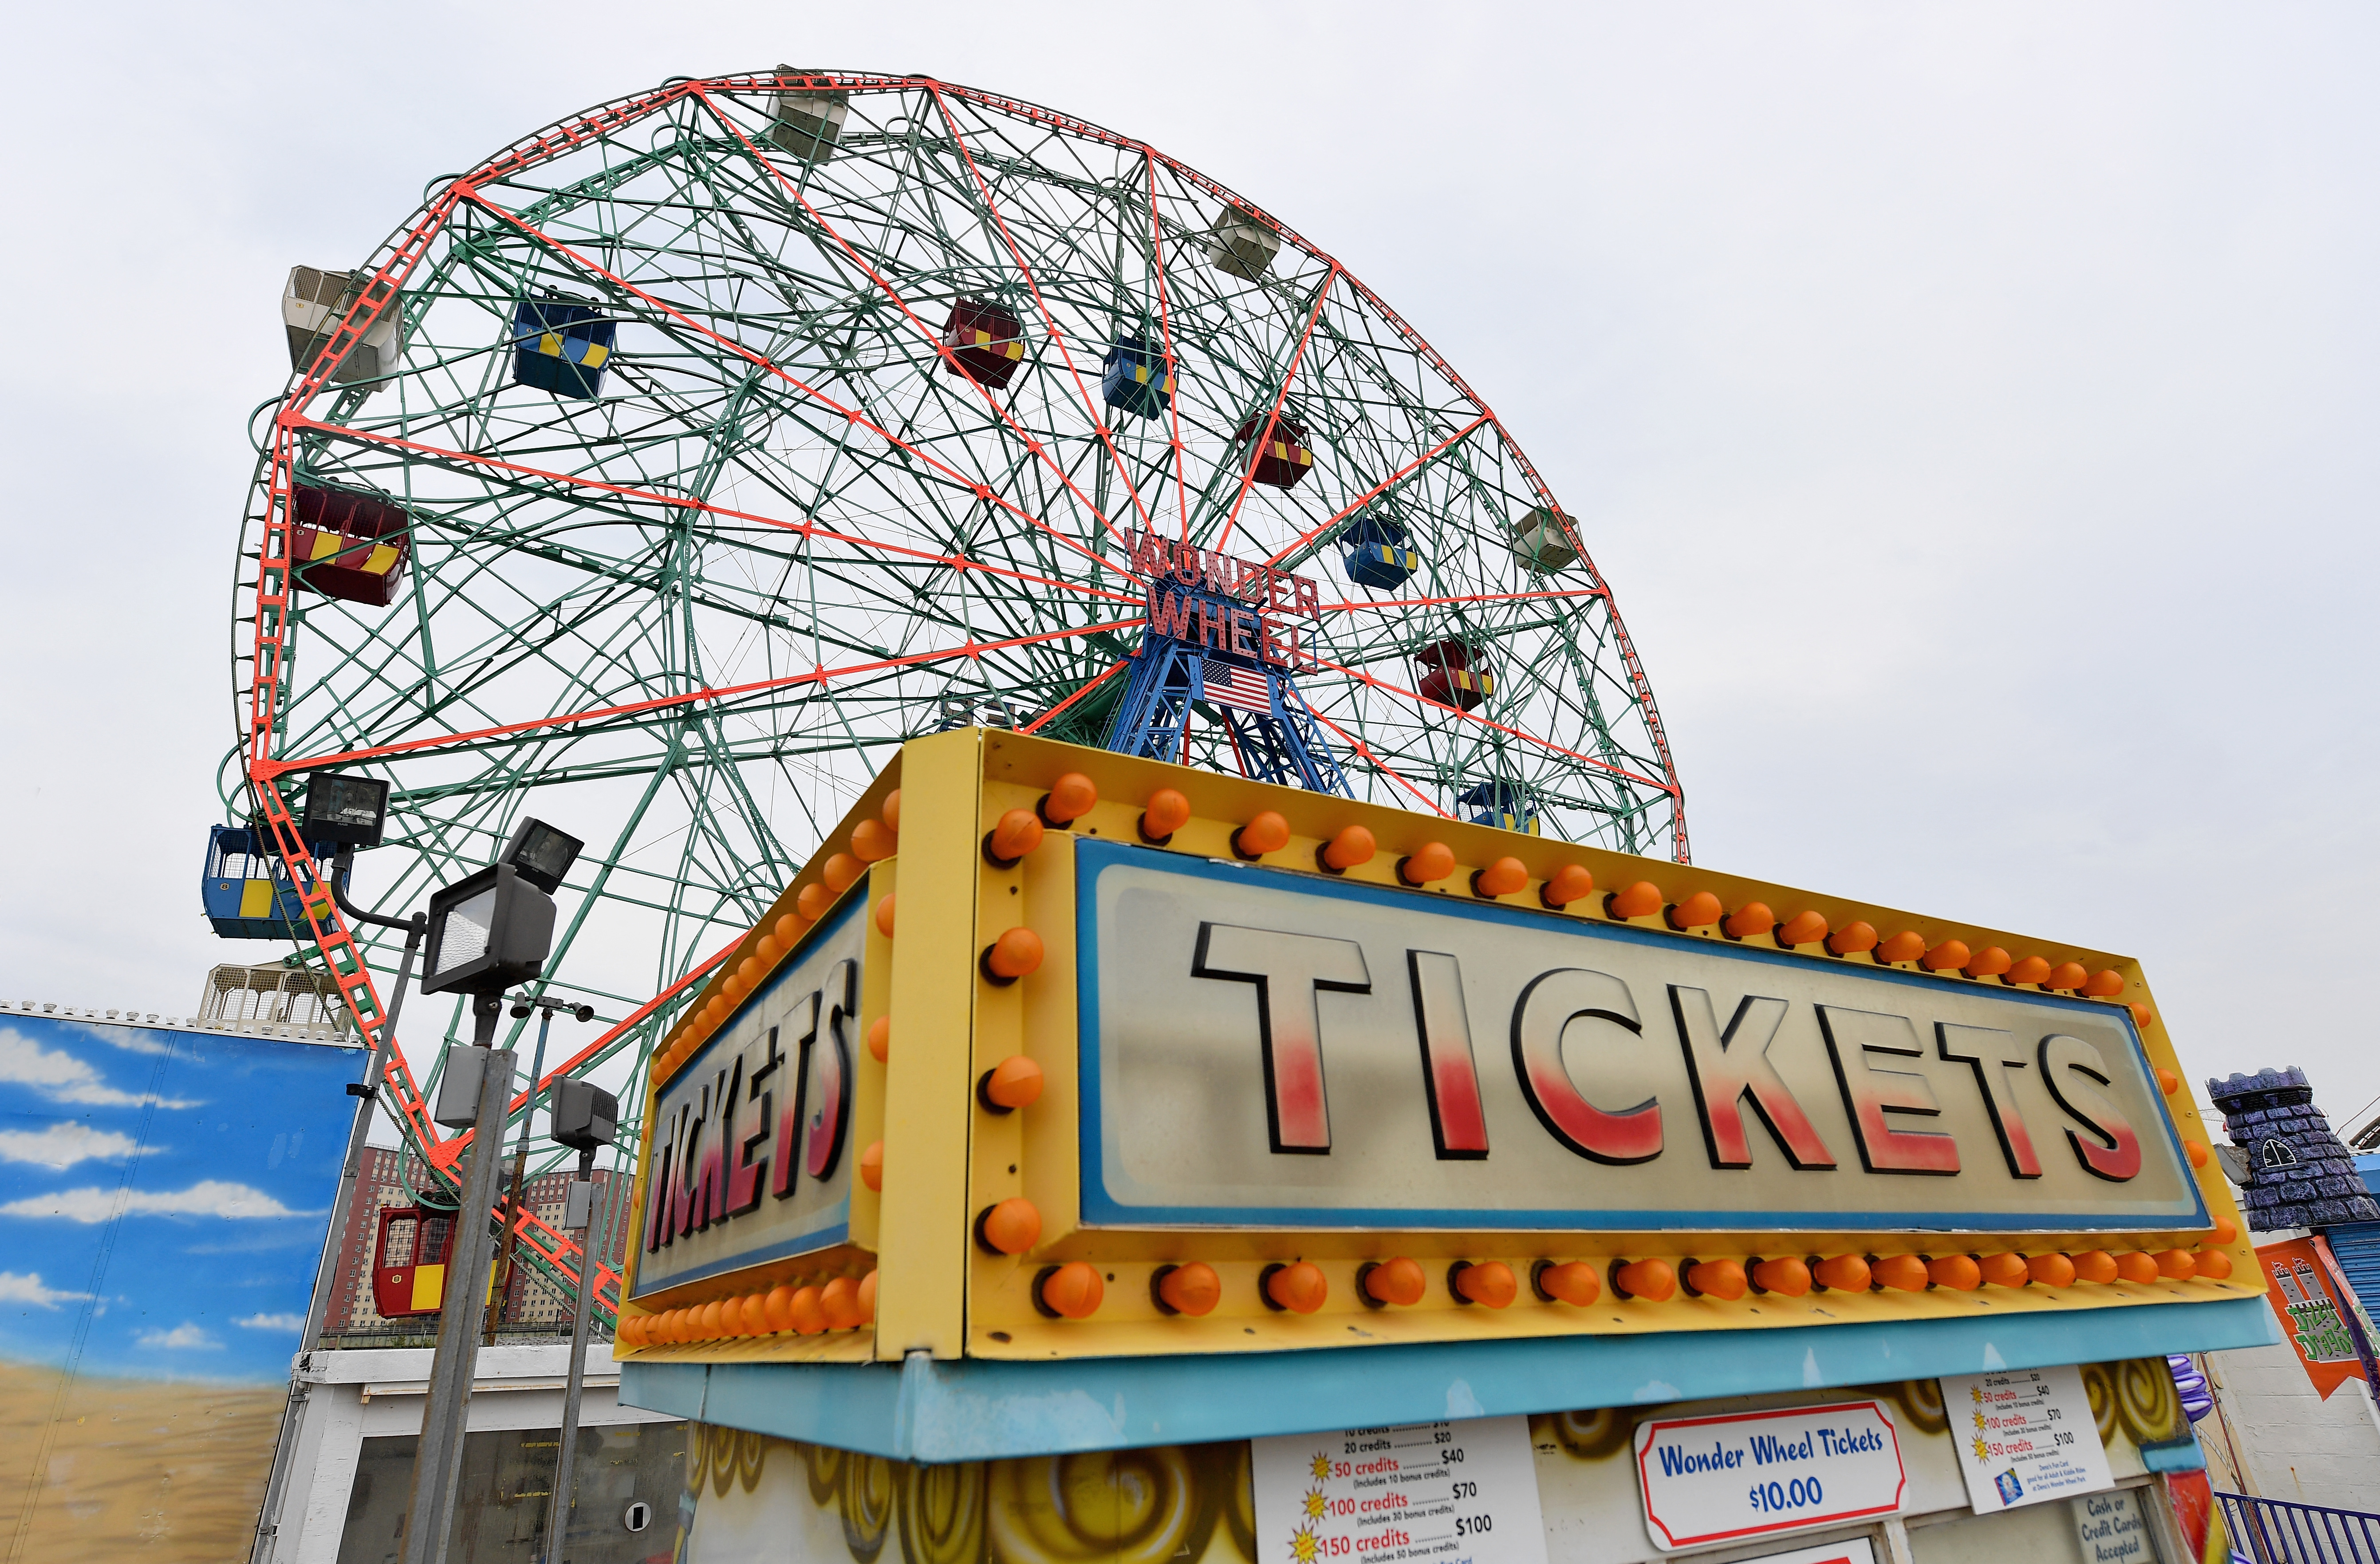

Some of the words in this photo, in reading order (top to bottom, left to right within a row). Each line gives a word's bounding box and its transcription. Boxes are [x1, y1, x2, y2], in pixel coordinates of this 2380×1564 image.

[1125, 527, 1320, 621] WONDER
[1146, 586, 1318, 675] WHEEL
[1191, 921, 2142, 1183] TICKETS
[646, 957, 858, 1254] TICKETS
[2287, 1303, 2341, 1332] Dizzy
[1983, 1392, 1993, 1402] 50
[1994, 1390, 2017, 1401] credits
[2037, 1385, 2049, 1396] $40
[1993, 1377, 2010, 1386] credits
[1986, 1417, 2001, 1429] 100
[2002, 1413, 2026, 1427] credits
[2047, 1409, 2061, 1420] $70
[1344, 1442, 1356, 1454] 20
[1359, 1440, 1391, 1453] credits
[1434, 1432, 1452, 1443] $20
[1658, 1442, 1745, 1477] Wonder
[1750, 1431, 1814, 1465] Wheel
[1817, 1427, 1883, 1457] Tickets
[1988, 1443, 2004, 1456] 150
[2006, 1438, 2033, 1454] credits
[2054, 1432, 2074, 1446] $100
[1335, 1461, 1351, 1478] 50
[1355, 1457, 1399, 1476] credits
[1442, 1449, 1464, 1465] $40
[1353, 1477, 1387, 1490] (Includes
[1389, 1474, 1398, 1484] 10
[1399, 1472, 1422, 1483] bonus
[1424, 1468, 1451, 1480] credits)
[1329, 1498, 1355, 1517] 100
[1360, 1492, 1408, 1513] credits
[1453, 1481, 1477, 1501] $70
[1749, 1476, 1822, 1512] $10.00
[2087, 1497, 2112, 1517] Cash
[2115, 1499, 2124, 1511] or
[1356, 1516, 1390, 1528] (Includes
[1392, 1512, 1402, 1521] 30
[1404, 1509, 1426, 1520] bonus
[1428, 1505, 1455, 1517] credits)
[2082, 1520, 2112, 1541] Credit
[2113, 1513, 2143, 1534] Cards
[1320, 1536, 1351, 1558] 150
[1356, 1528, 1410, 1552] credits
[1456, 1514, 1492, 1537] $100
[1397, 1548, 1407, 1559] 50
[1407, 1548, 1430, 1558] bonus
[1432, 1540, 1460, 1554] credits)
[2095, 1535, 2140, 1564] Accepted
